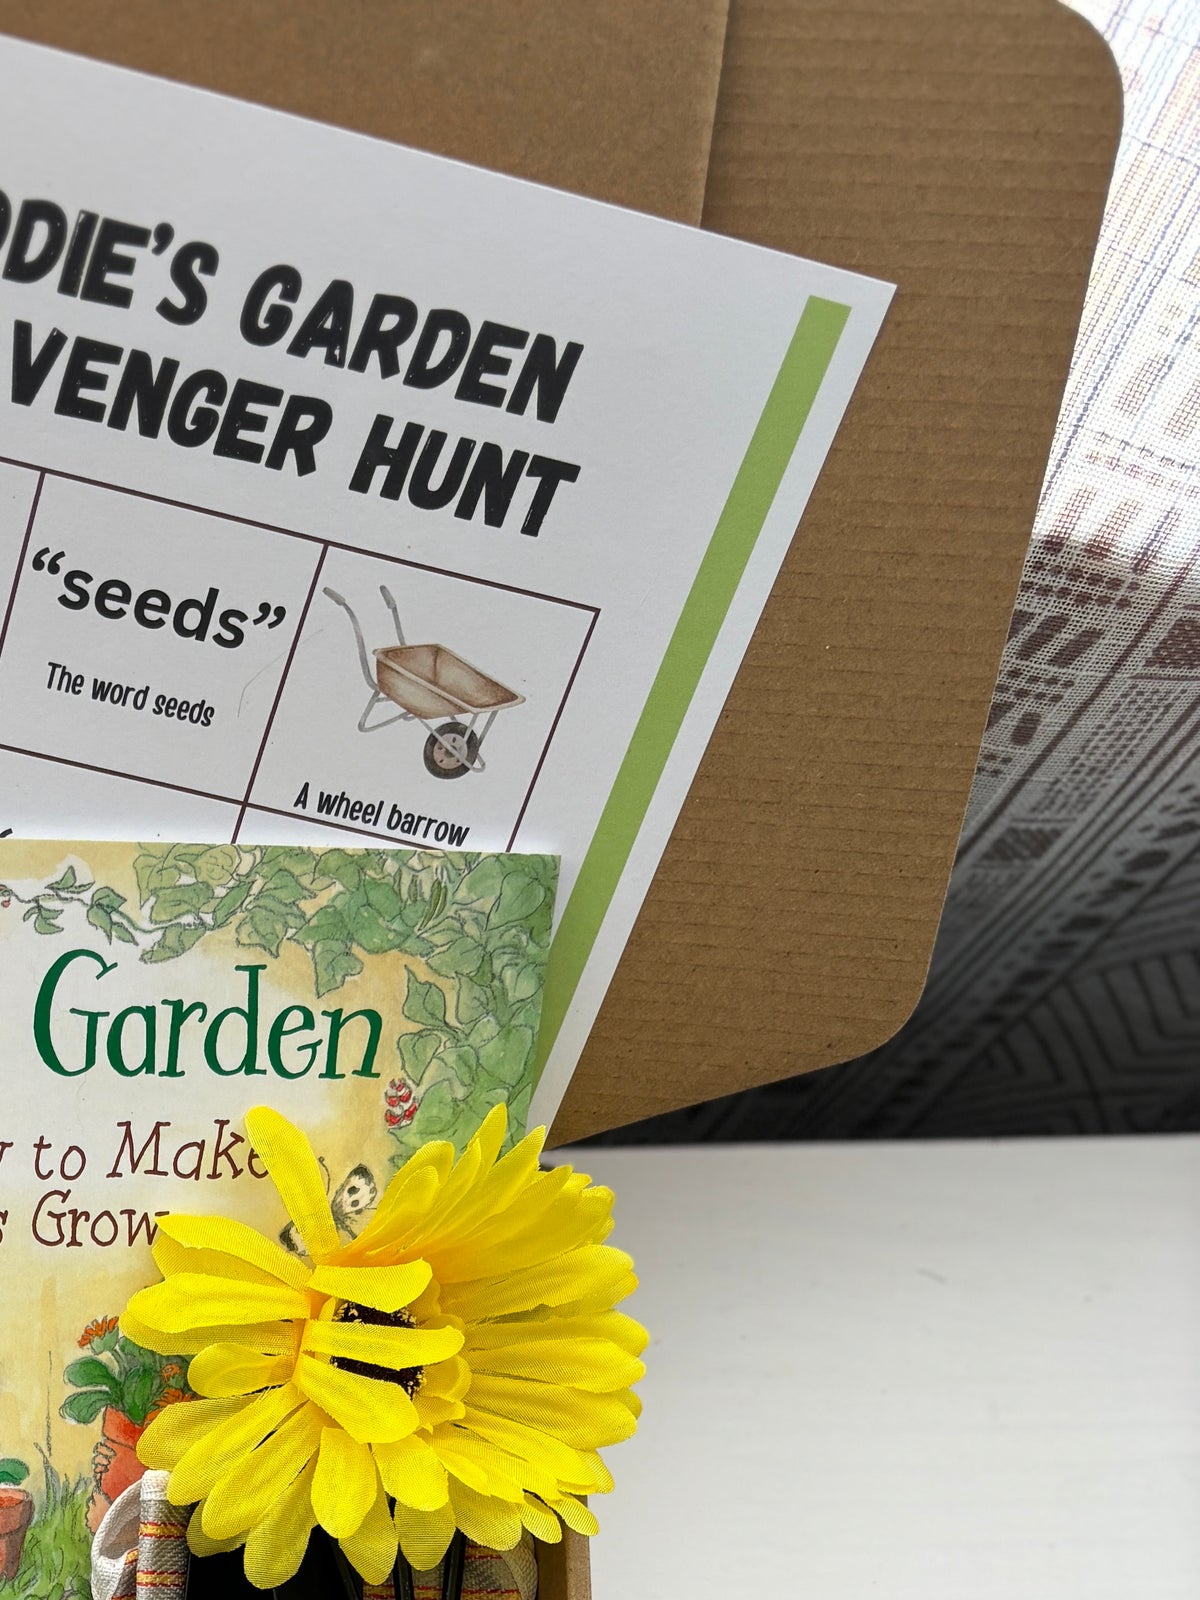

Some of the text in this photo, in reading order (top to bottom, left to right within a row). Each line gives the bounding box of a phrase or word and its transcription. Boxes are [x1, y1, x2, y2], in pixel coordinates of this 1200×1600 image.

[239, 265, 585, 425] GARDEN
[346, 411, 582, 540] HUNT
[46, 662, 215, 728] The word seeds
[293, 781, 471, 848] A wheel barrow
[32, 948, 384, 1082] Garden
[35, 1136, 88, 1182] to
[106, 1119, 270, 1181] Make
[30, 1191, 170, 1250] Grow
